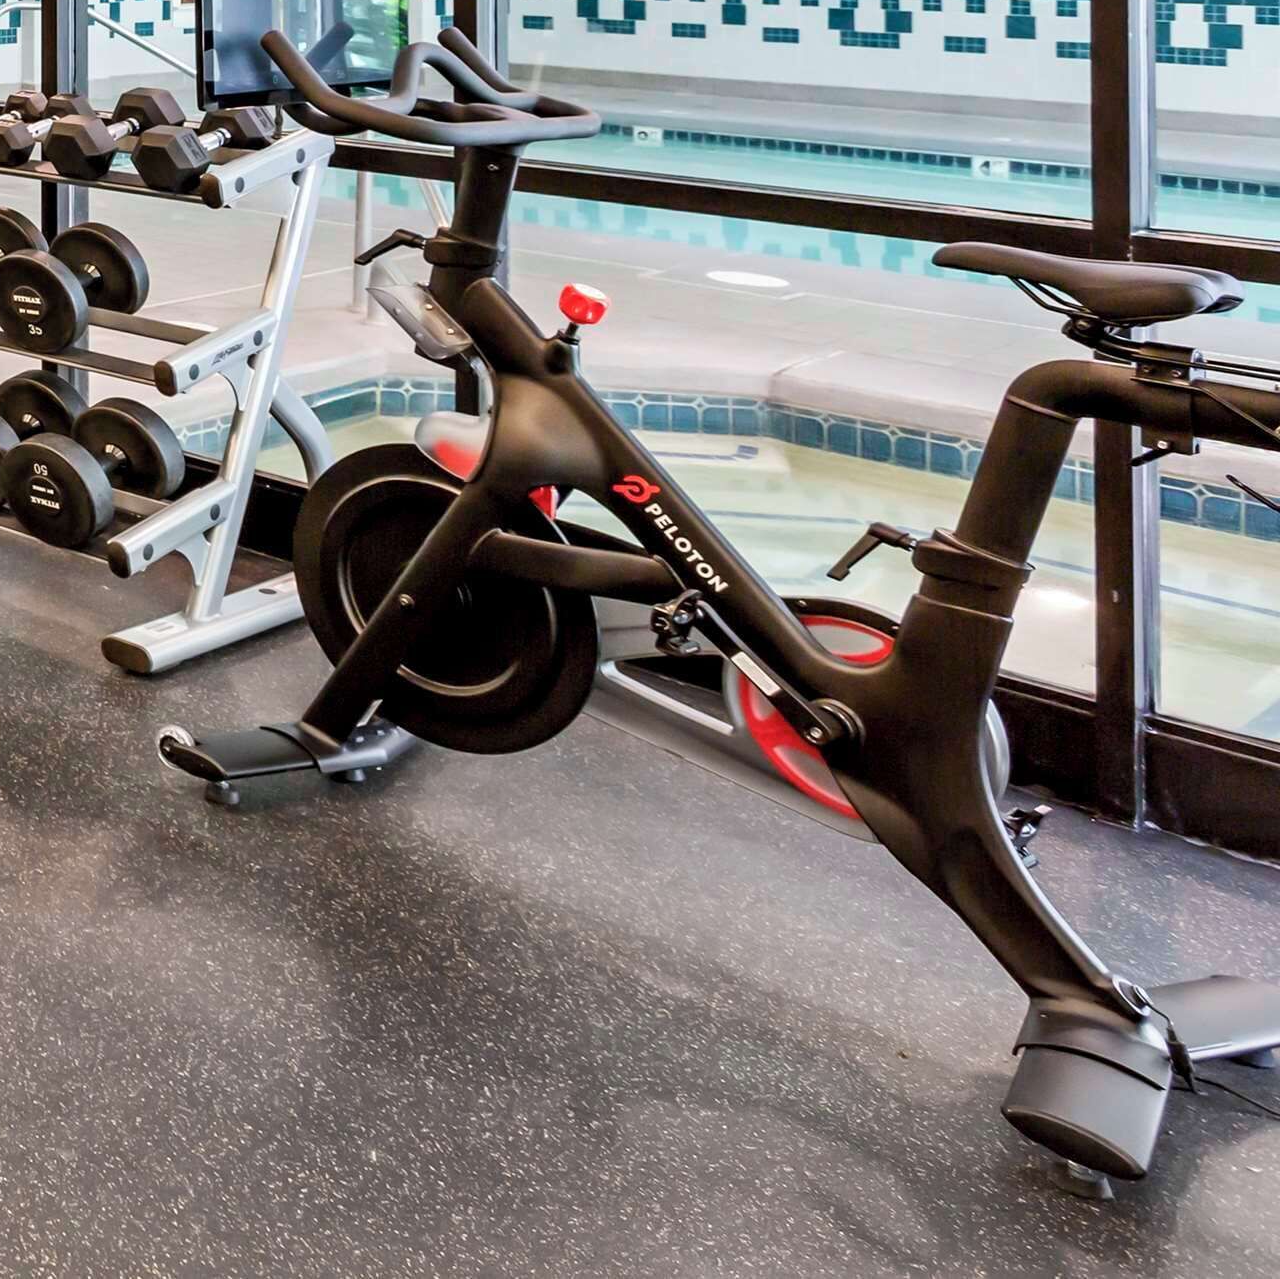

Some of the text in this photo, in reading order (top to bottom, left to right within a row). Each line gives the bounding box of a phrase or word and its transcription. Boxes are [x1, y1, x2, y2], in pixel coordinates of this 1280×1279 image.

[13, 294, 42, 305] FITMAX
[33, 462, 48, 476] 50
[644, 503, 729, 593] PELOTON
